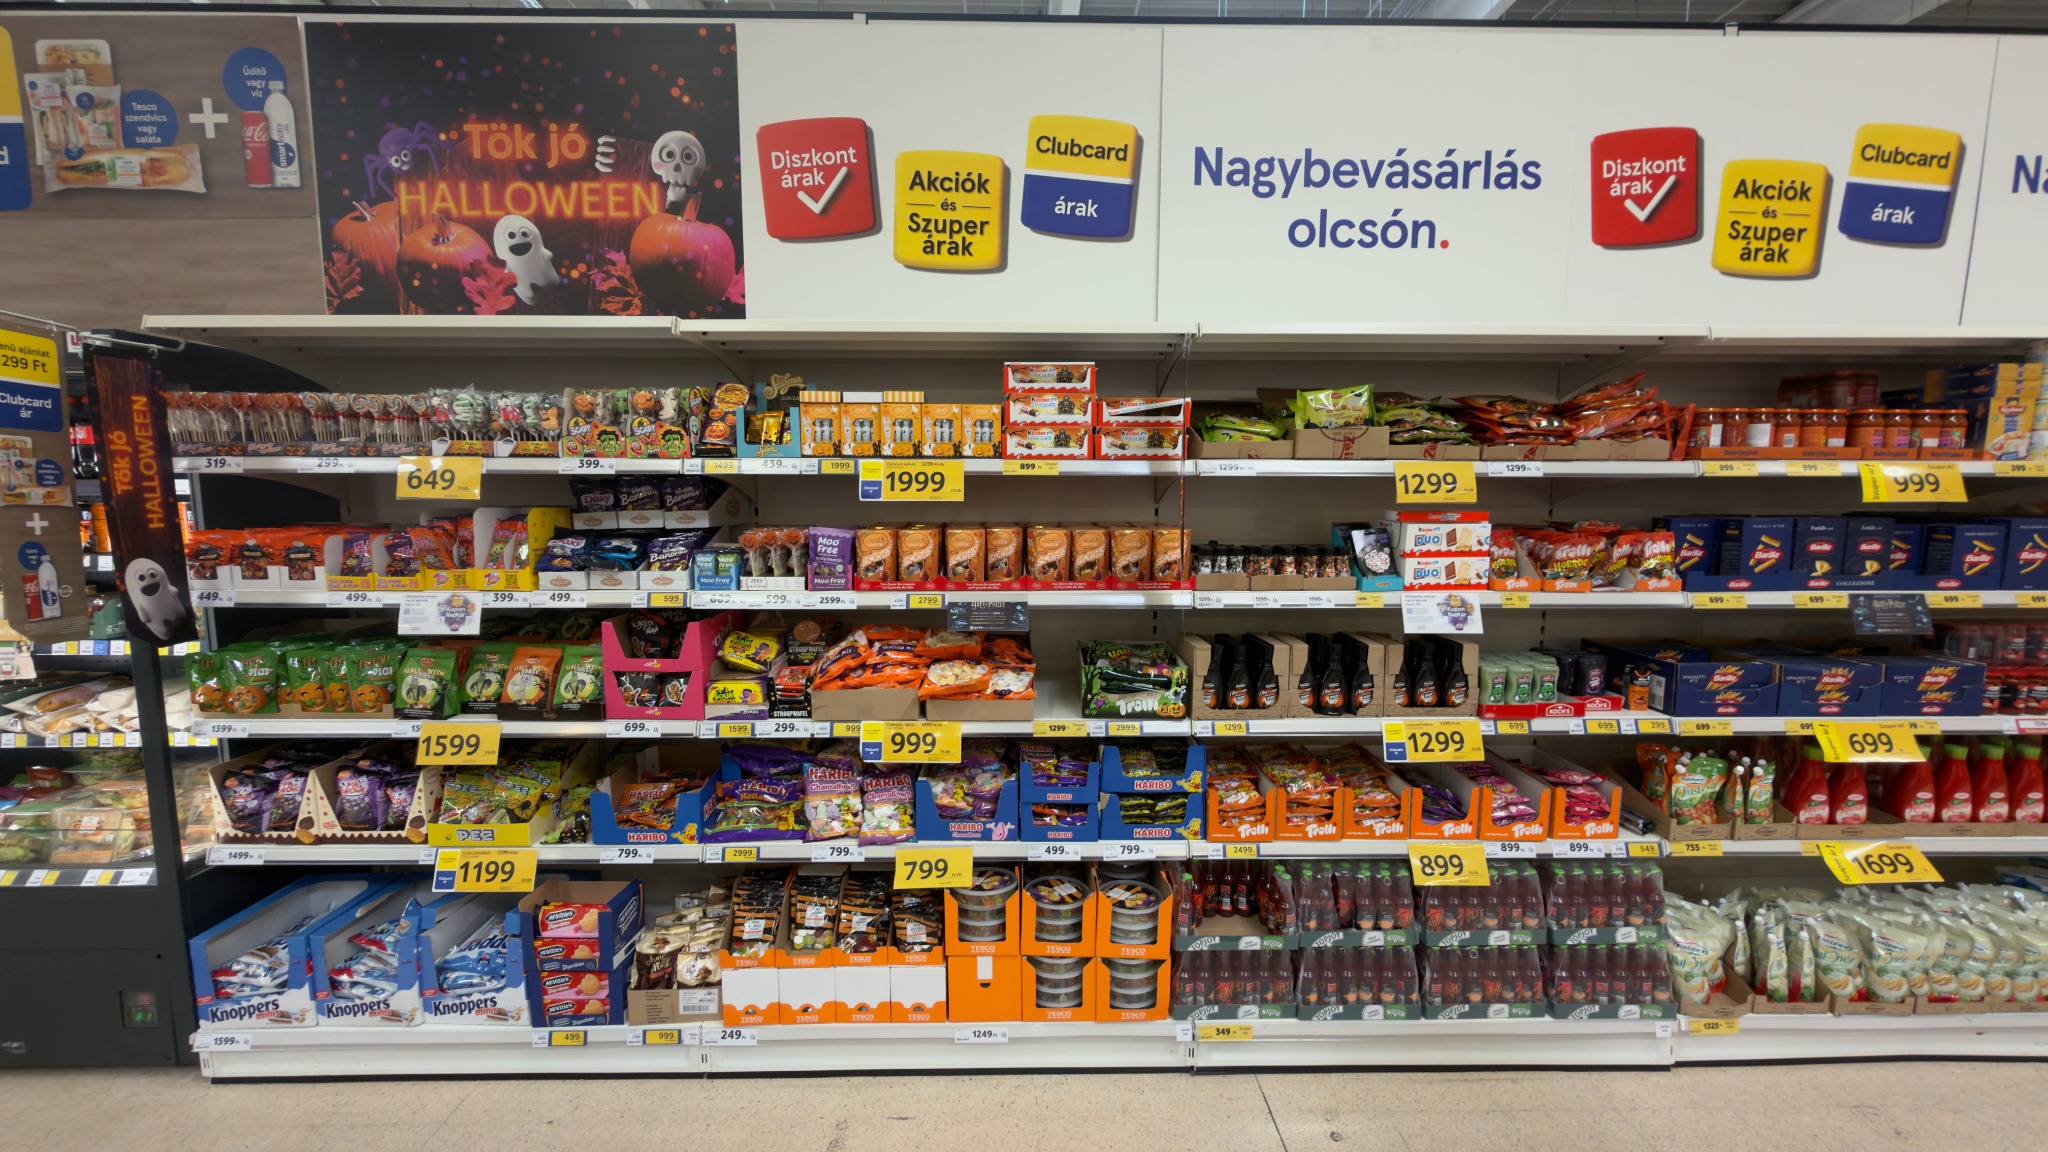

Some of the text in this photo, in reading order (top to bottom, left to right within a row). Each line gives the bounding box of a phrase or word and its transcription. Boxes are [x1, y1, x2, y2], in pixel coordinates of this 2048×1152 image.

[246, 78, 266, 89] vagy
[250, 88, 264, 98] víz
[131, 103, 158, 112] Tesco
[125, 113, 168, 122] szendvics
[138, 125, 158, 135] vagy
[463, 123, 587, 168] Tök jó
[1035, 135, 1129, 162] Clubcard
[771, 145, 857, 170] Diszkont
[1860, 143, 1952, 170] Clubcard
[1602, 154, 1686, 179] Diszkont
[781, 167, 826, 189] árak
[1193, 146, 1543, 199] Nagybevásárlás
[908, 170, 990, 195] Akciók
[1610, 176, 1653, 197] árak
[1733, 178, 1813, 202] Akciók
[398, 180, 661, 219] HALLOWEEN
[940, 198, 957, 211] és
[1054, 197, 1098, 218] árak
[1762, 205, 1778, 219] és
[1871, 205, 1916, 225] árak
[908, 212, 990, 239] Szuper
[1287, 208, 1450, 250] olcsón.
[1728, 219, 1807, 244] Szuper
[922, 234, 973, 257] árak
[1739, 241, 1789, 263] árak
[33, 359, 48, 373] Ft
[0, 392, 52, 409] Clubcard
[19, 407, 33, 418] ár
[570, 424, 592, 435] SCARY
[633, 424, 656, 435] SCARY
[108, 430, 134, 495] Tök jó
[132, 395, 166, 529] HALLOWEEN
[204, 458, 226, 468] 319
[317, 458, 339, 468] 299
[578, 459, 600, 469] 399
[714, 461, 733, 469] 1499
[761, 458, 783, 469] 439
[830, 462, 851, 470] 1999
[1505, 464, 1527, 472] 1299
[1719, 464, 1734, 472] 999
[407, 468, 456, 491] 649
[885, 471, 946, 492] 1999
[1398, 472, 1458, 495] 1299
[1893, 472, 1941, 493] 999
[817, 536, 840, 546] Moo
[1415, 534, 1440, 547] DUO
[817, 545, 839, 555] Free
[1808, 543, 1832, 551] Barilla
[1860, 543, 1883, 551] Barilla
[1679, 549, 1704, 558] Barilla
[1753, 550, 1780, 560] Barilla
[1965, 553, 1991, 563] Barilla
[1414, 567, 1438, 579] DUO
[715, 576, 730, 584] Free
[197, 591, 219, 601] 449
[345, 592, 367, 602] 499
[492, 592, 514, 602] 399
[550, 592, 571, 602] 499
[819, 596, 841, 604] 2599
[918, 596, 938, 604] 2799
[1586, 700, 1609, 710] KOCH'S
[1549, 707, 1571, 716] KOCH'S
[211, 725, 233, 733] 1399
[624, 722, 646, 732] 699
[728, 725, 748, 733] 1599
[774, 722, 795, 733] 299
[1048, 724, 1066, 732] 1299
[1223, 723, 1243, 731] 1299
[1509, 722, 1525, 730] 699
[1598, 721, 1614, 729] 699
[1650, 721, 1666, 729] 299
[1695, 723, 1710, 731] 699
[421, 733, 481, 757] 1599
[890, 732, 937, 754] 999
[1407, 730, 1465, 753] 1299
[1848, 732, 1895, 754] 699
[1134, 780, 1173, 790] HARIBO
[1047, 793, 1073, 801] HARIBO
[949, 823, 984, 832] HARIBO
[1133, 828, 1172, 838] HARIBO
[1237, 822, 1269, 839] Trolli
[1305, 822, 1338, 838] Trolli
[1372, 820, 1404, 837] Trolli
[1441, 821, 1473, 837] Trolli
[1511, 821, 1544, 838] Trolli
[456, 829, 496, 842] PEZ
[627, 832, 667, 843] HARIBO
[1047, 831, 1073, 839] HARIBO
[829, 847, 850, 857] 799
[1044, 845, 1065, 855] 499
[1119, 845, 1140, 855] 799
[1233, 846, 1254, 854] 2499
[1500, 843, 1520, 852] 899
[1569, 843, 1589, 852] 899
[1640, 844, 1655, 852] 549
[1685, 843, 1700, 851] 755
[227, 851, 250, 860] 1499
[617, 848, 639, 858] 799
[732, 849, 754, 857] 2999
[903, 858, 949, 881] 799
[1419, 854, 1464, 877] 899
[1851, 853, 1915, 876] 1699
[459, 860, 516, 883] 1199
[1314, 932, 1344, 947] TOPJOY
[1568, 928, 1595, 945] TOPJOY
[1188, 936, 1218, 951] TOPJOY
[209, 998, 282, 1025] Knoppers minis
[326, 998, 392, 1019] Knoppers minis
[432, 996, 499, 1017] Knoppers minis
[572, 1016, 595, 1027] Digestives
[1703, 1022, 1720, 1030] 1325
[564, 1033, 580, 1041] 499
[658, 1032, 675, 1040] 999
[720, 1029, 742, 1040] 249
[972, 1030, 993, 1038] 1249
[1215, 1027, 1231, 1036] 349
[213, 1035, 236, 1046] 1599
